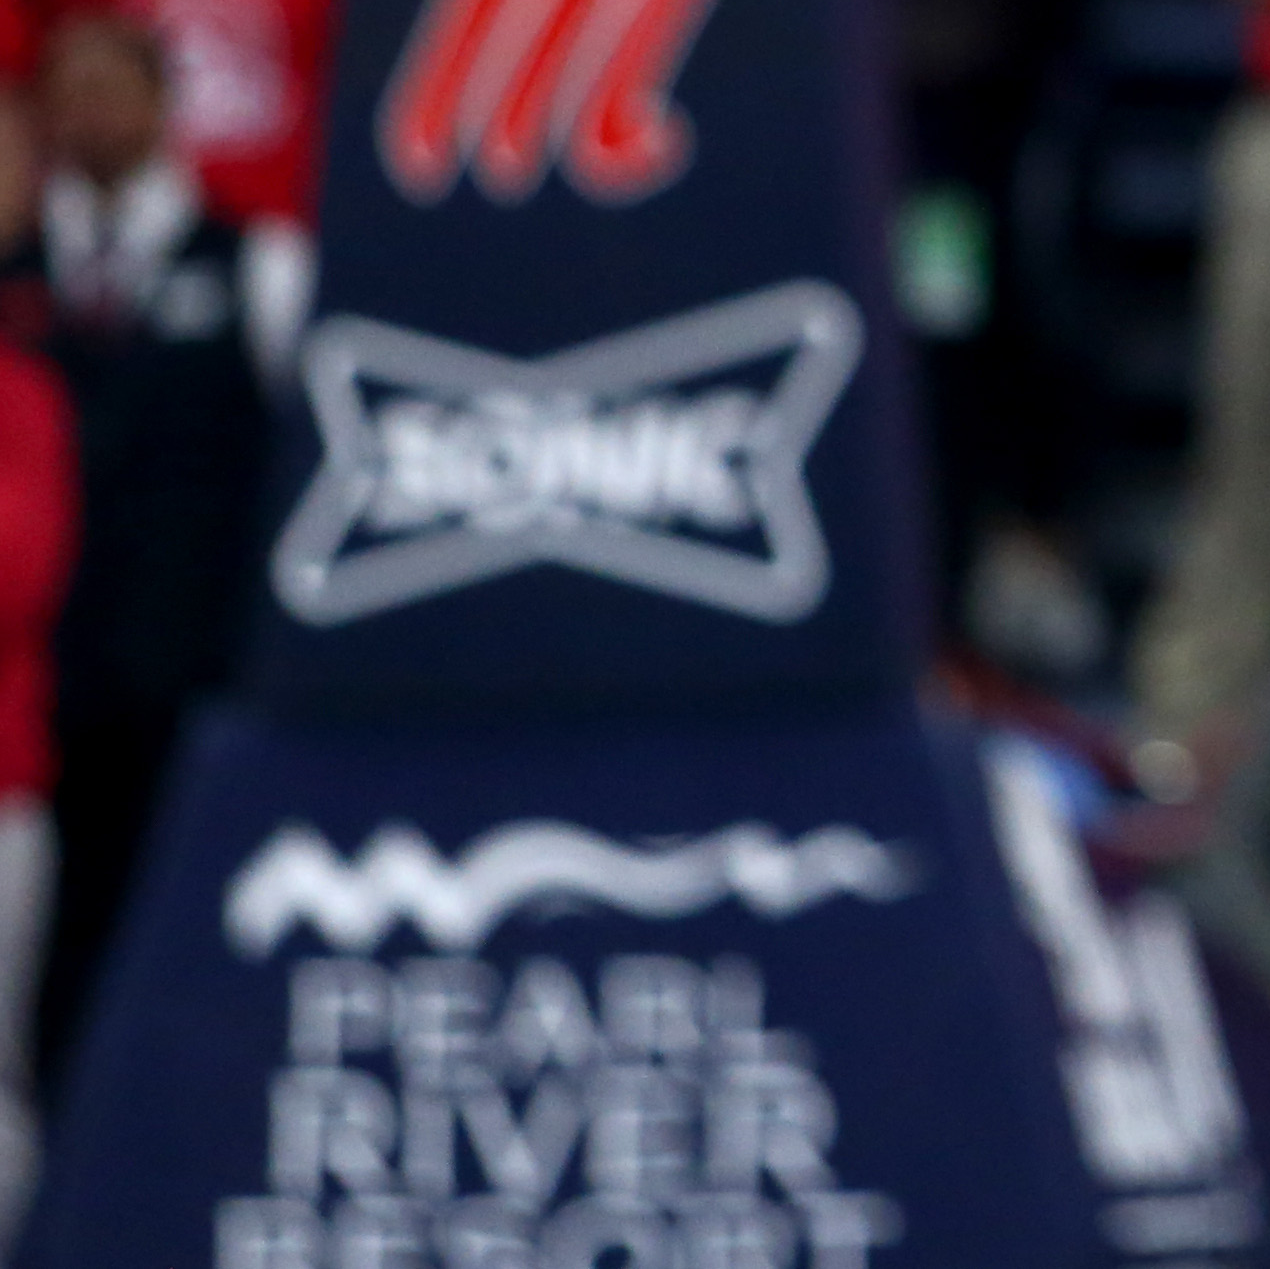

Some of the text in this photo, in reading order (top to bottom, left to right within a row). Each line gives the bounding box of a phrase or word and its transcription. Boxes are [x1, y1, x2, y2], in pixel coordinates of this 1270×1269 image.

[368, 390, 762, 532] SONIC
[286, 952, 816, 1066] PEARL
[266, 1064, 839, 1198] RIVER
